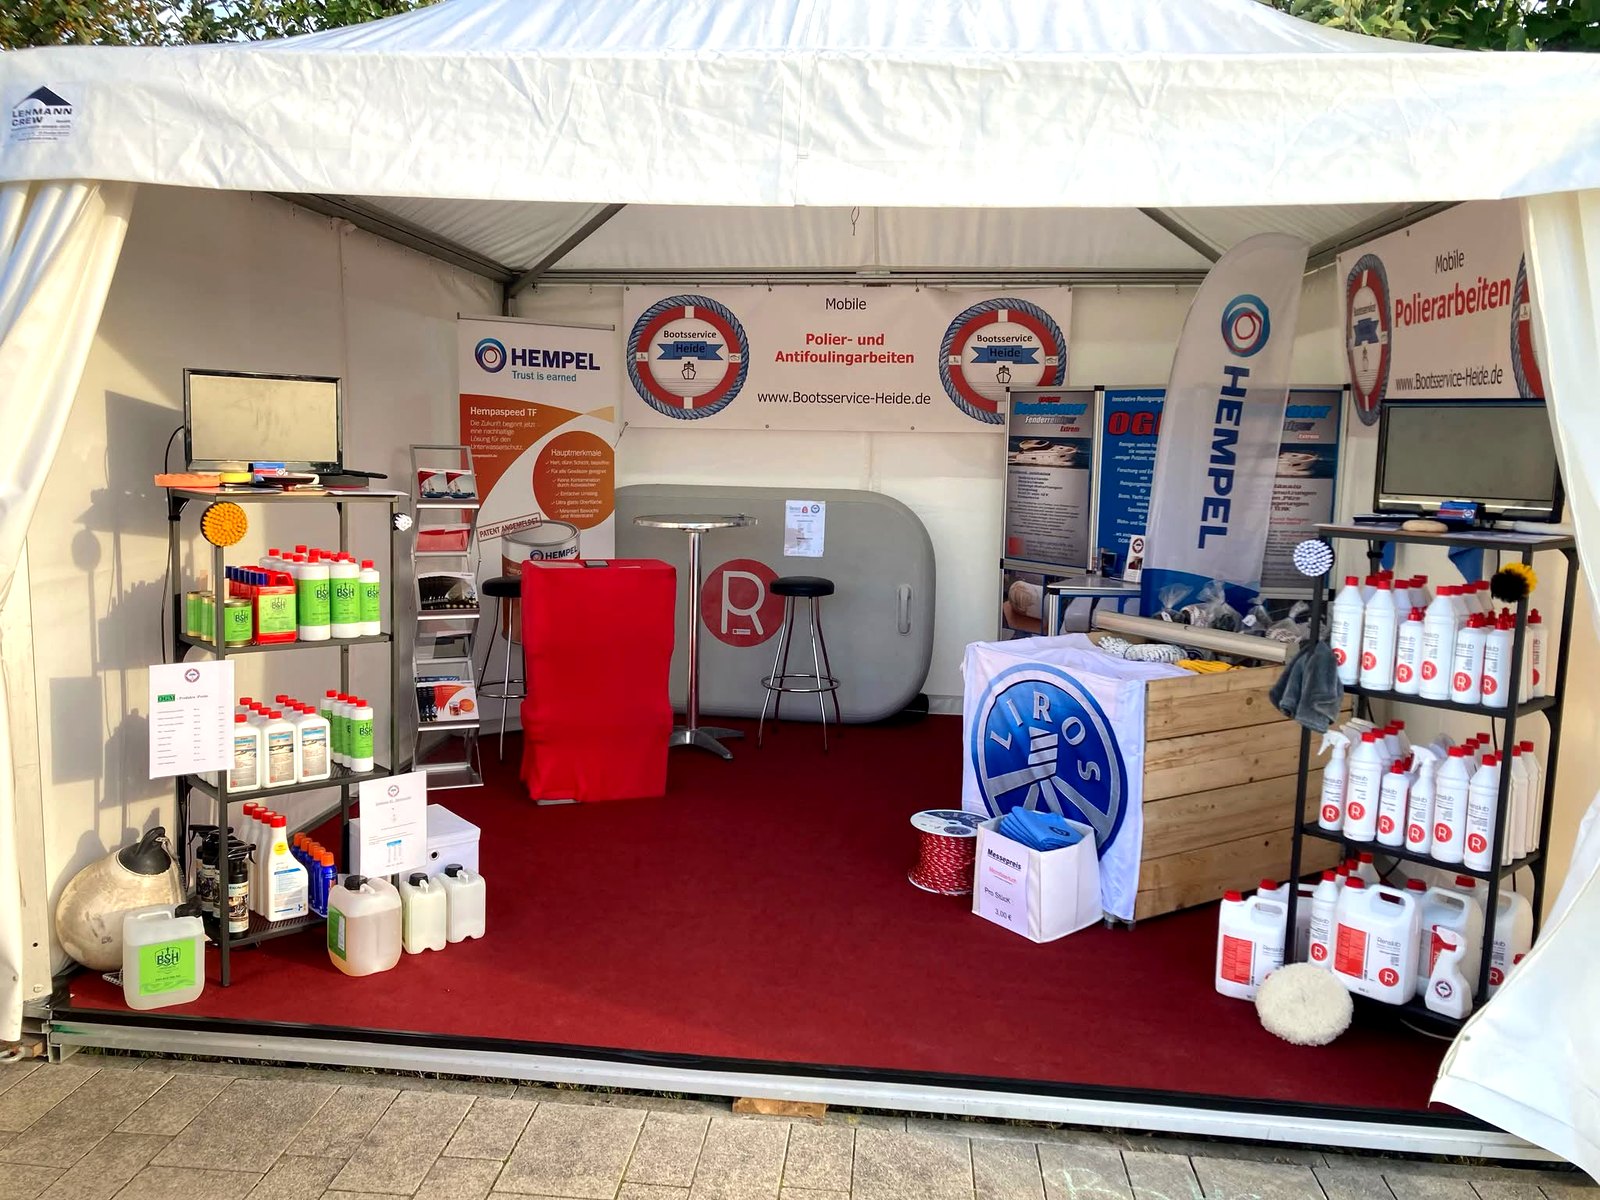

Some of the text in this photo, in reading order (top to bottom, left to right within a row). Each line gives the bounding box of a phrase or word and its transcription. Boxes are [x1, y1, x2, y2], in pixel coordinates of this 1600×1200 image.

[12, 108, 72, 118] LEHMANN
[11, 116, 43, 126] CREW
[1435, 249, 1465, 274] Mobile
[825, 297, 867, 310] Mobile
[1395, 276, 1512, 328] Polierarbeiten
[663, 330, 717, 339] Bootsservice
[806, 333, 885, 346] Polier- und
[976, 334, 1033, 343] Bootsservice
[675, 344, 706, 353] Heide
[989, 347, 1021, 358] Heide
[511, 348, 600, 371] HEMPEL
[775, 350, 915, 366] Antifoulingarbeiten
[512, 370, 577, 382] Trust is earned
[1395, 364, 1503, 391] www.Bootsservice-Heide.de
[757, 391, 932, 405] www.Bootsservice-Heide.de
[470, 406, 537, 418] Hempaspeed TF
[1198, 365, 1250, 549] HEMPEL
[479, 526, 501, 539] PATENT
[545, 545, 579, 560] HEMPEL
[721, 571, 766, 635] R
[1457, 676, 1467, 688] R
[990, 690, 1101, 782] LIROS
[1471, 837, 1482, 850] R
[988, 848, 1022, 871] Messepreis
[984, 886, 995, 897] Pro
[1385, 972, 1395, 984] R
